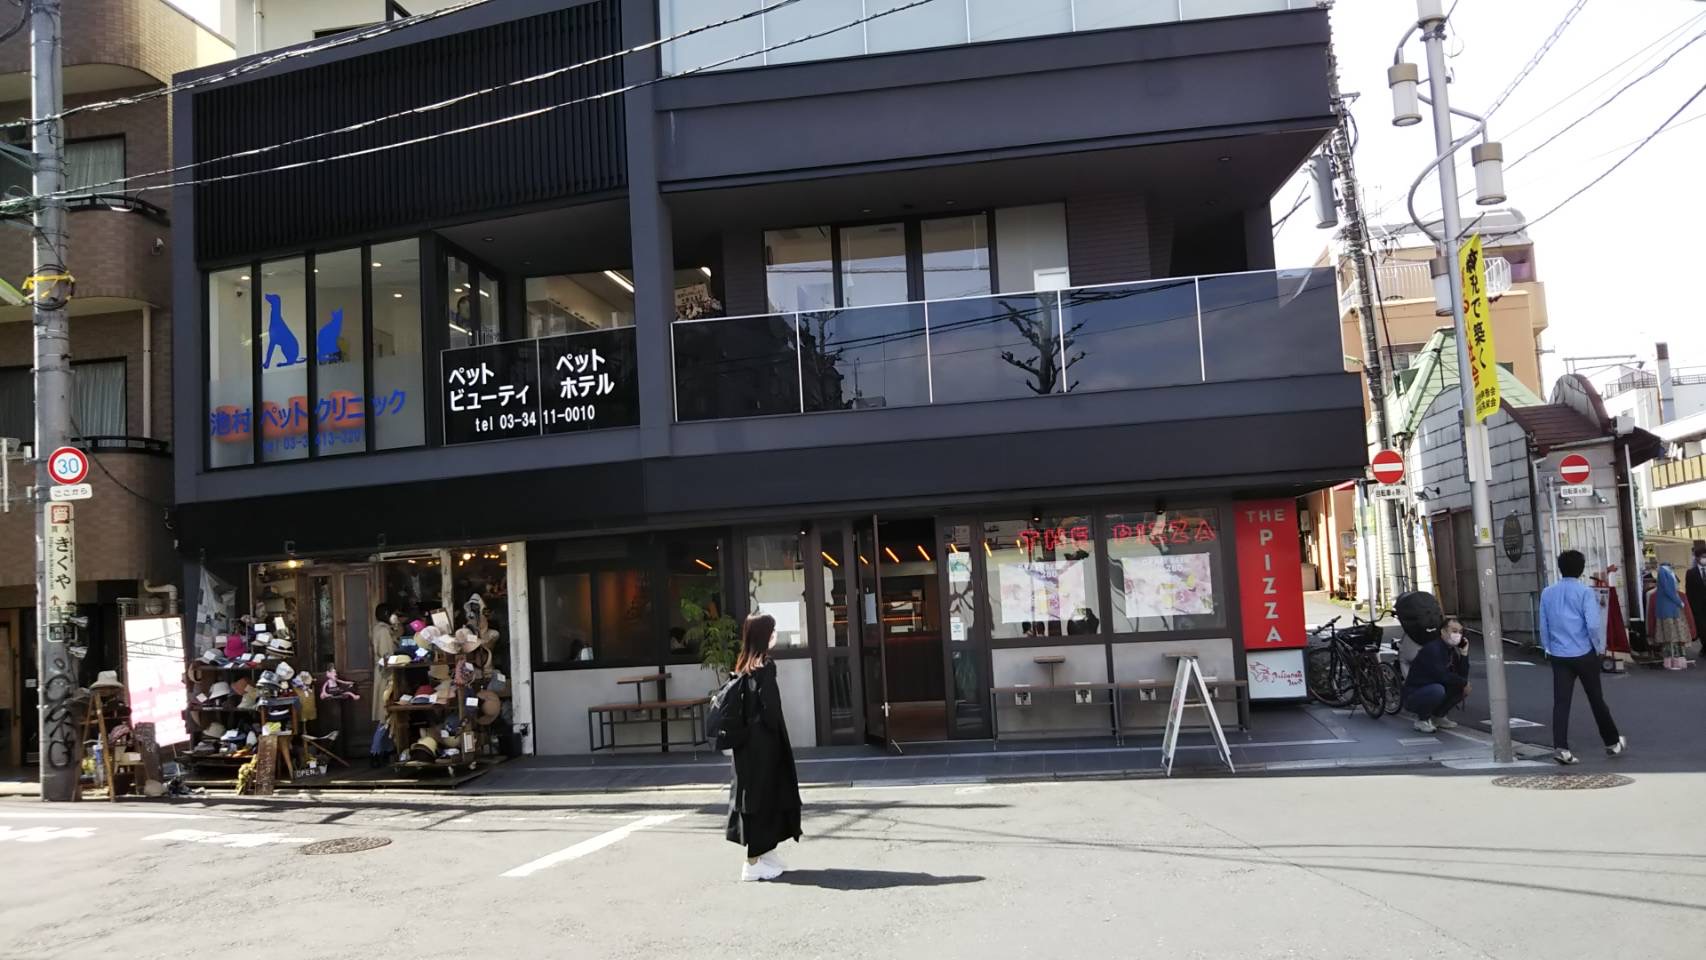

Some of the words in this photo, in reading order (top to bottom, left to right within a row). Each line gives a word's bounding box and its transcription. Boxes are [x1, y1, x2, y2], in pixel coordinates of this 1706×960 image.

[556, 348, 606, 373] ペット
[449, 362, 494, 386] ペット
[560, 373, 615, 399] ホテル
[450, 385, 530, 411] ビューティ
[475, 416, 493, 432] tel
[57, 457, 79, 474] 30
[54, 488, 88, 497] ここから
[1246, 509, 1286, 523] THE
[1019, 526, 1089, 552] THE
[1112, 520, 1217, 546] PIZZA
[55, 536, 71, 589] きくや
[1259, 529, 1283, 643] PIZZA
[296, 769, 316, 778] OPEN
